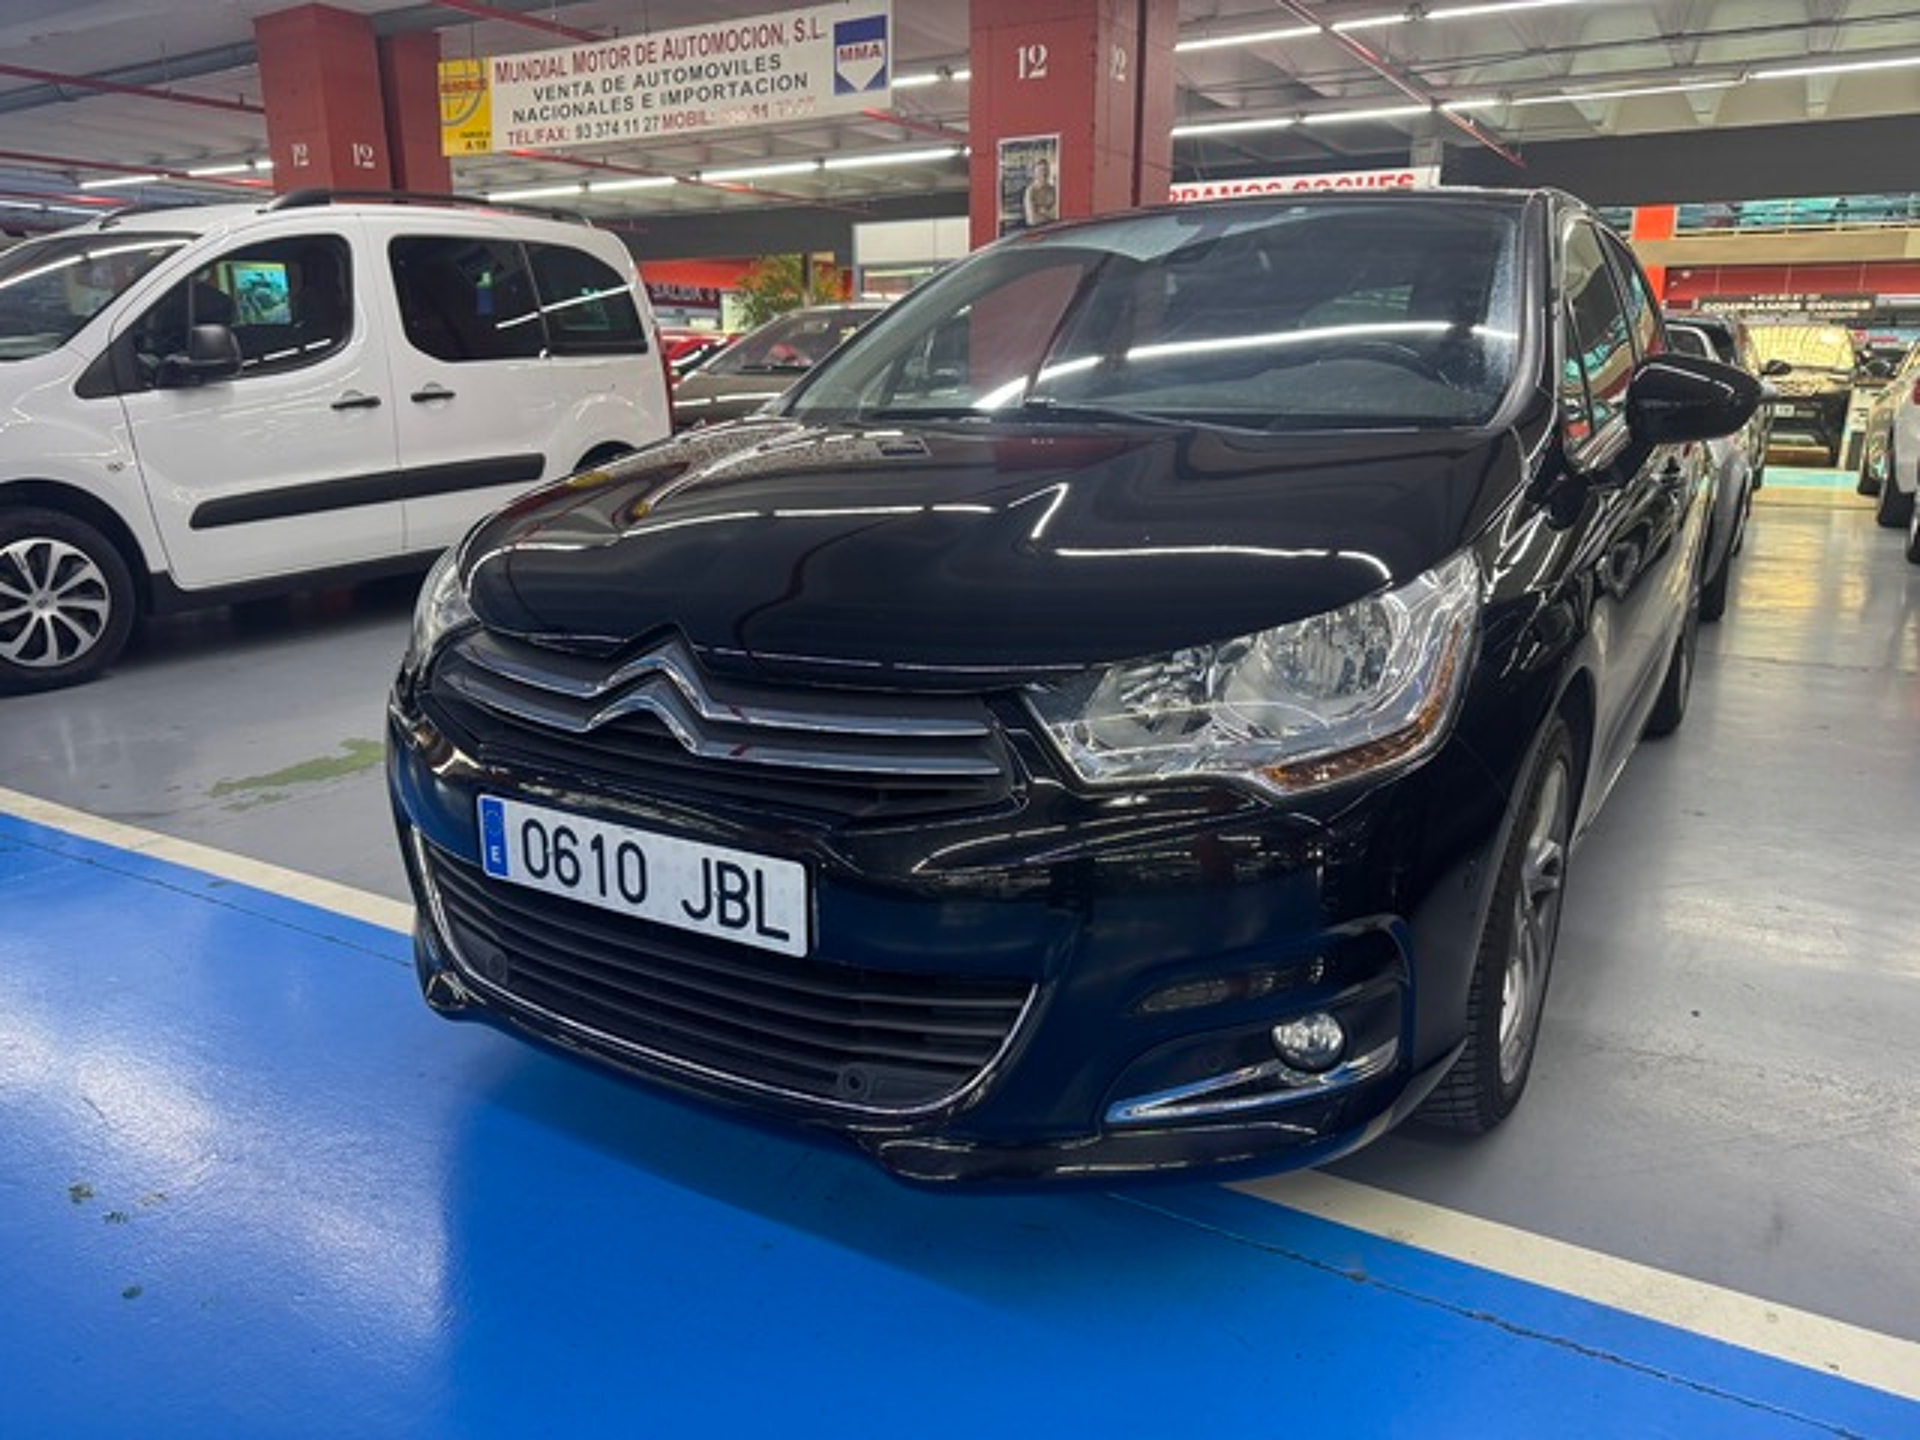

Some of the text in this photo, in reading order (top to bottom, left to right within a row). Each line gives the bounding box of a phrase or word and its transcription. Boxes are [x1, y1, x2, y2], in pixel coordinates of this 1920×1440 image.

[495, 57, 567, 83] MUNDIAL
[573, 45, 630, 74] MOTOR
[636, 41, 657, 65] DE
[839, 43, 881, 62] MMA
[1018, 44, 1048, 79] 12
[1110, 44, 1126, 82] 12
[534, 54, 781, 102] VENTA DE AUTOMOVILES
[513, 95, 634, 123] NACIONALES
[642, 93, 652, 108] E
[660, 71, 808, 106] IMPORTACION
[596, 120, 619, 138] 374
[625, 119, 639, 133] 11
[644, 117, 659, 133] 27
[291, 142, 309, 167] 12
[352, 142, 375, 169] 12
[491, 846, 501, 863] E
[521, 818, 790, 941] 0610 JBL
